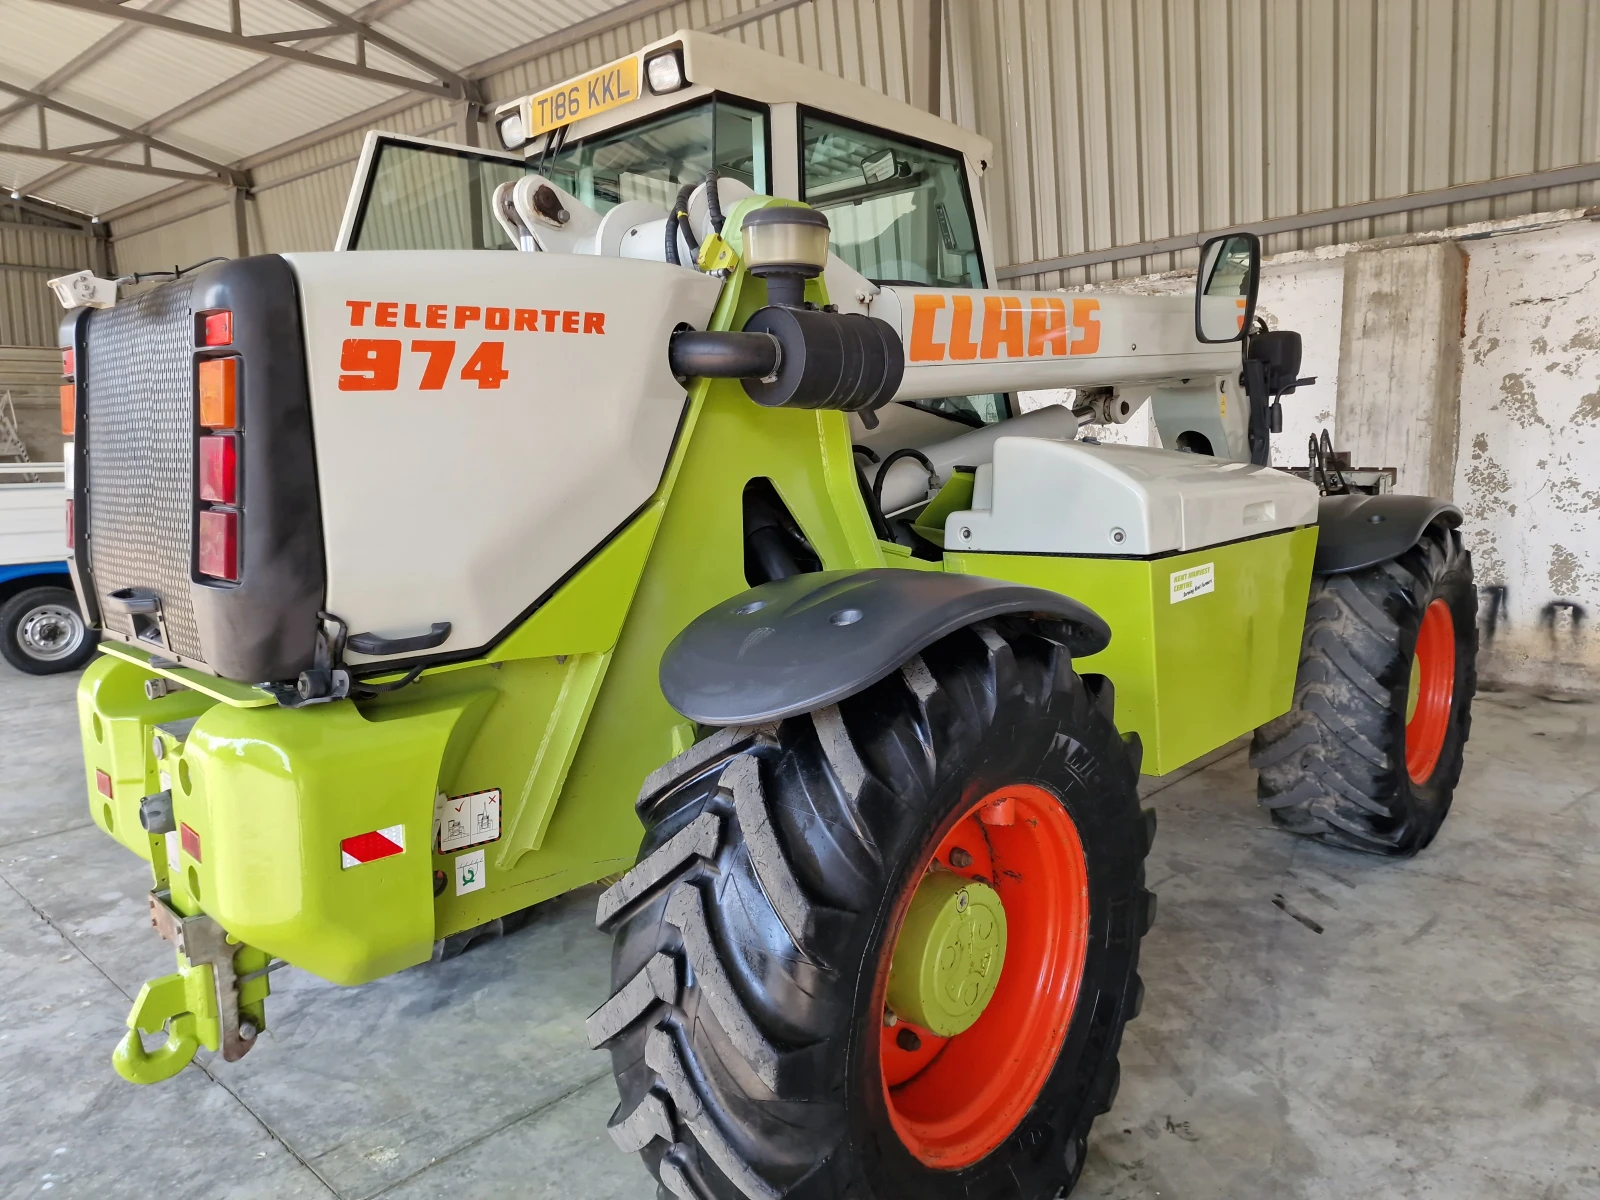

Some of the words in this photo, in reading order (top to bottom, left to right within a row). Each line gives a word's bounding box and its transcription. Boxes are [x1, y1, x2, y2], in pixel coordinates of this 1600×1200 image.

[538, 86, 580, 127] T186
[587, 68, 630, 110] KKL
[346, 300, 605, 334] TELEPORTER
[909, 294, 1101, 362] CLAAS
[338, 338, 509, 391] 974
[1174, 573, 1187, 583] KENT
[1174, 581, 1192, 592] CENTRE
